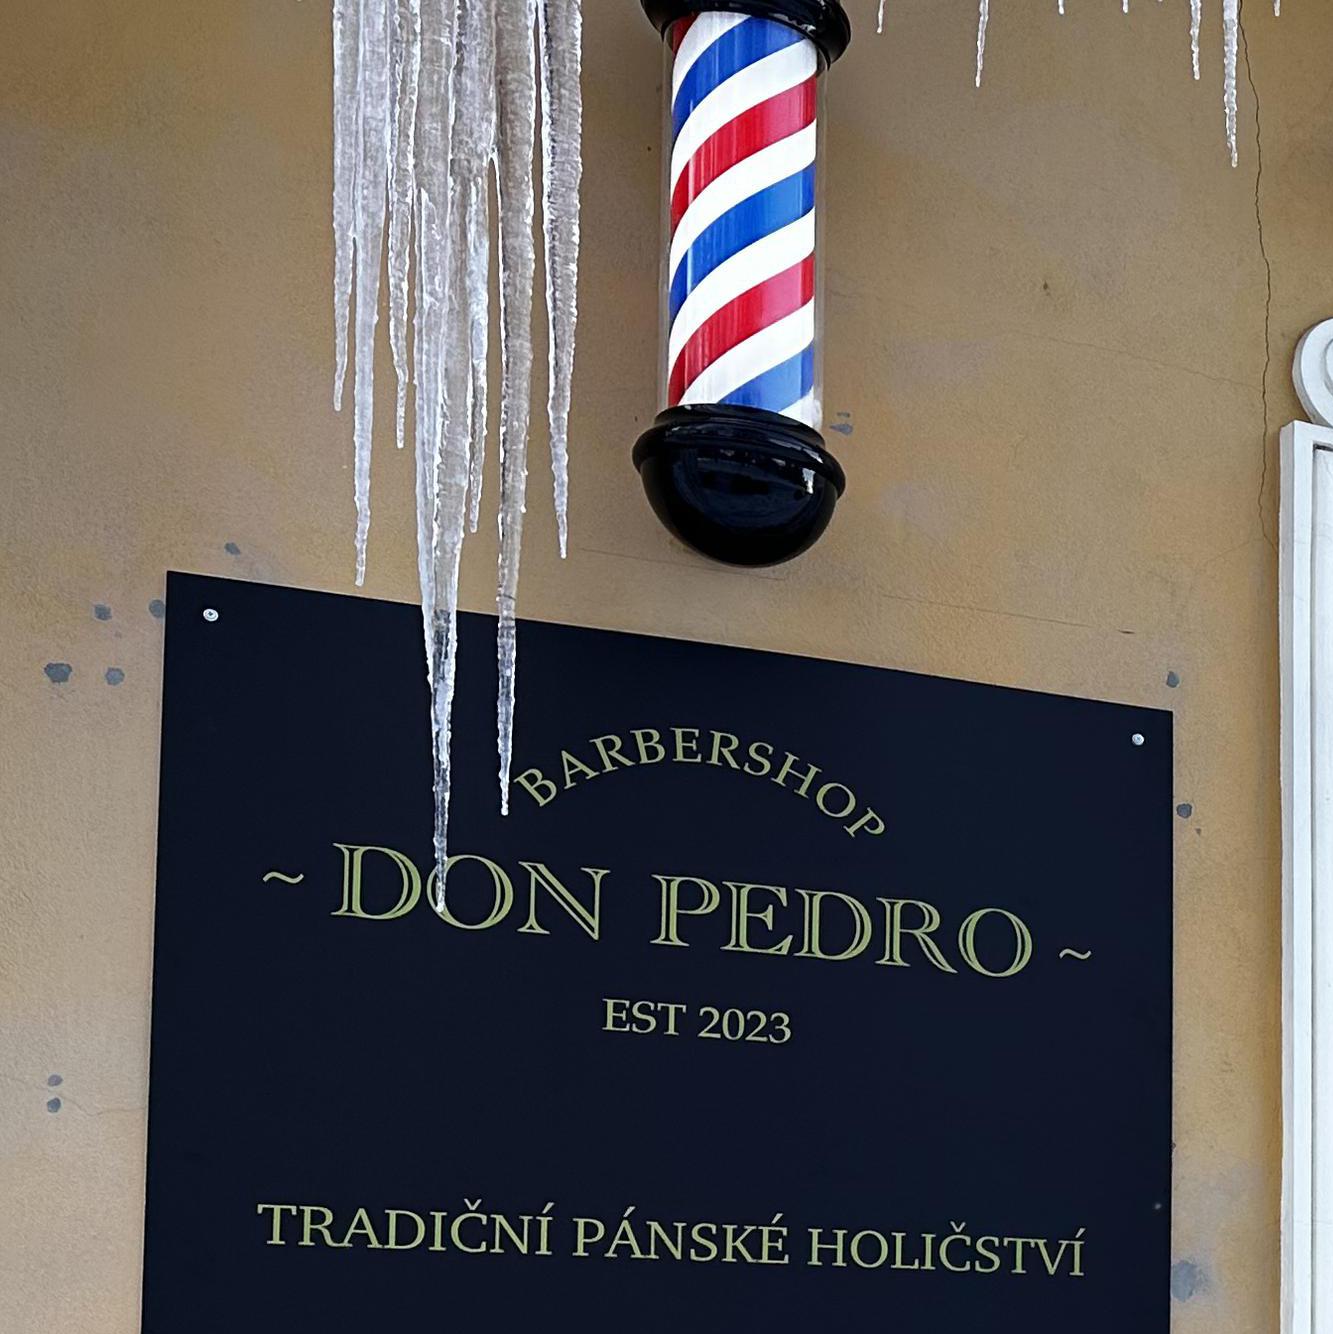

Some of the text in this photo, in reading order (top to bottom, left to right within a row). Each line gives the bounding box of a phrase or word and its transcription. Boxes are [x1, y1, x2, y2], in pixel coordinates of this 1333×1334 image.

[512, 726, 886, 841] BARBERSHOP
[330, 842, 611, 941] DON
[650, 873, 1034, 978] PEDRO
[601, 998, 792, 1044] EST 2023
[257, 1198, 1087, 1277] TRADIČNÍ PÁNSKÉ HOLIČSTVÍ
